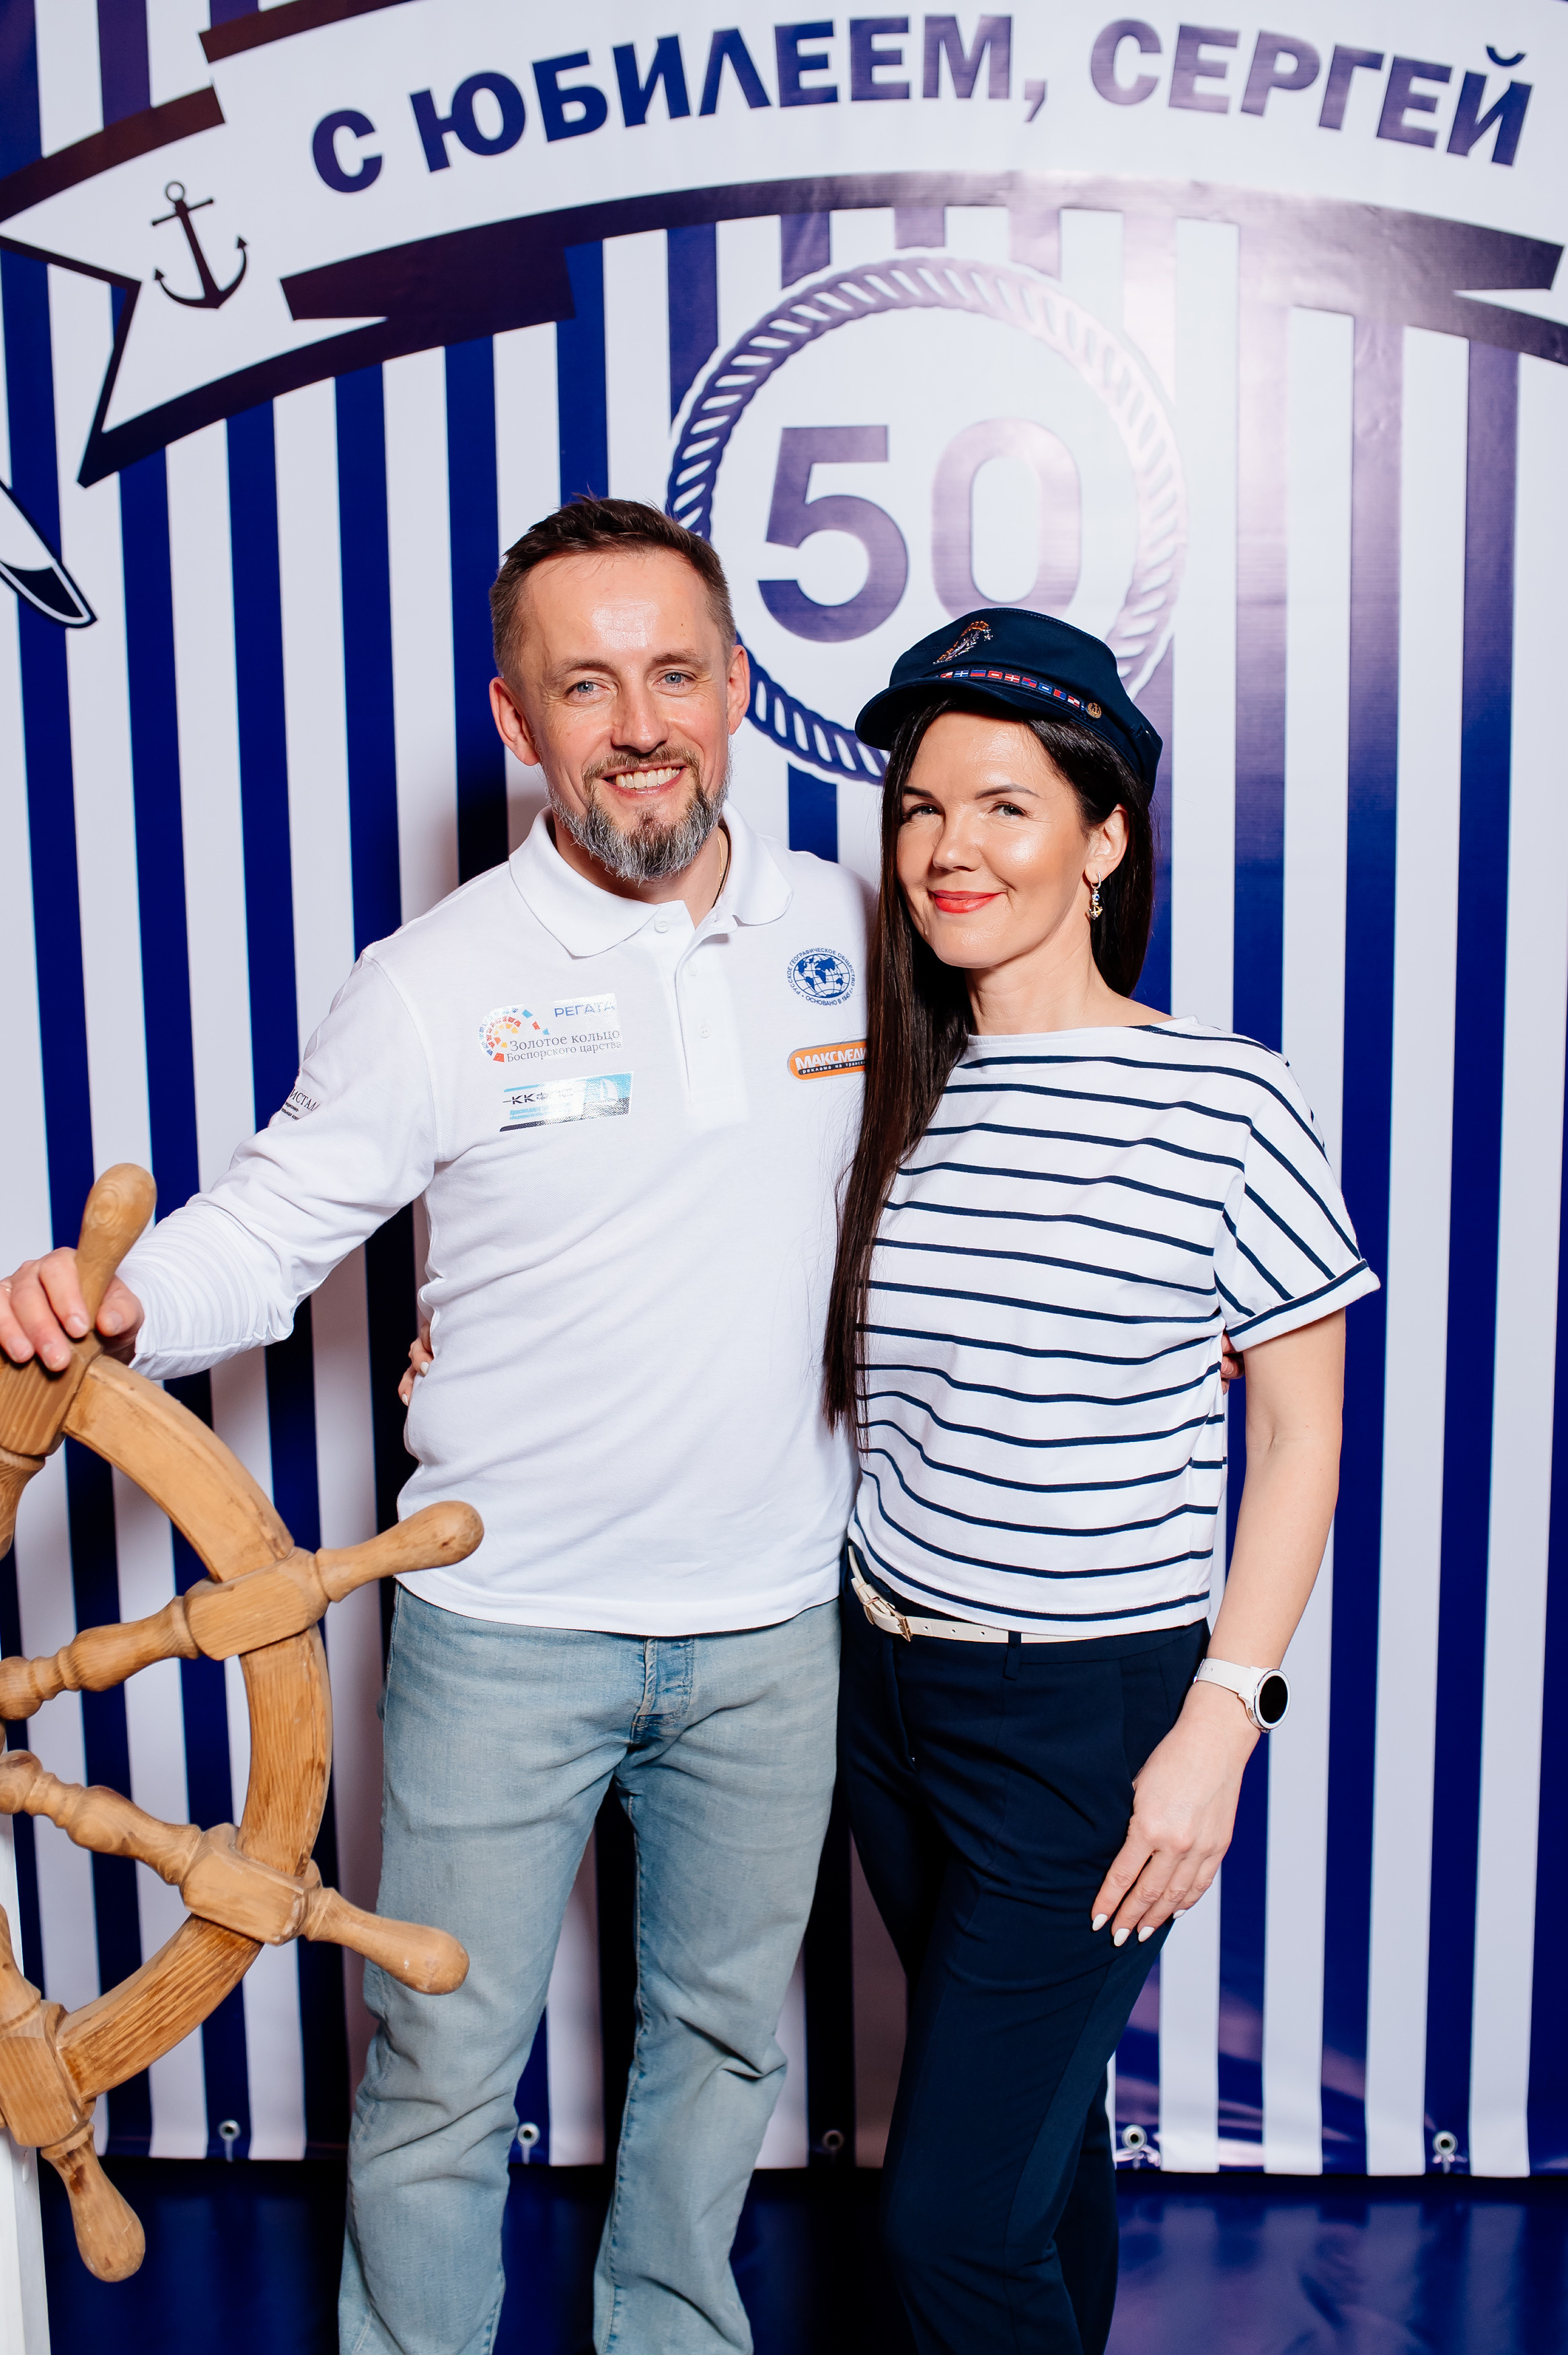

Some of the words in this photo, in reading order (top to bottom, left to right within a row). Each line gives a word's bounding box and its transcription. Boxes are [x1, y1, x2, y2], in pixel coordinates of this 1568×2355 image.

[311, 108, 383, 194] С
[409, 14, 1047, 173] ЮБИЛЕЕМ,
[1090, 18, 1533, 167] СЕРГЕЙ
[756, 416, 1082, 644] 50
[789, 947, 836, 967] ГЕОГРАФИЧЕСКОЕ
[787, 966, 800, 995] РУССКОЕ
[837, 953, 856, 986] ОБЩЕСТВО
[805, 995, 837, 1006] ОСНОВАНО
[507, 1046, 576, 1062] Боспорского
[579, 1042, 622, 1054] царства
[509, 1036, 568, 1052] Золотое
[571, 1030, 620, 1044] кольцо
[794, 1047, 866, 1070] МАКСМЕДИ
[802, 1065, 831, 1074] реклама
